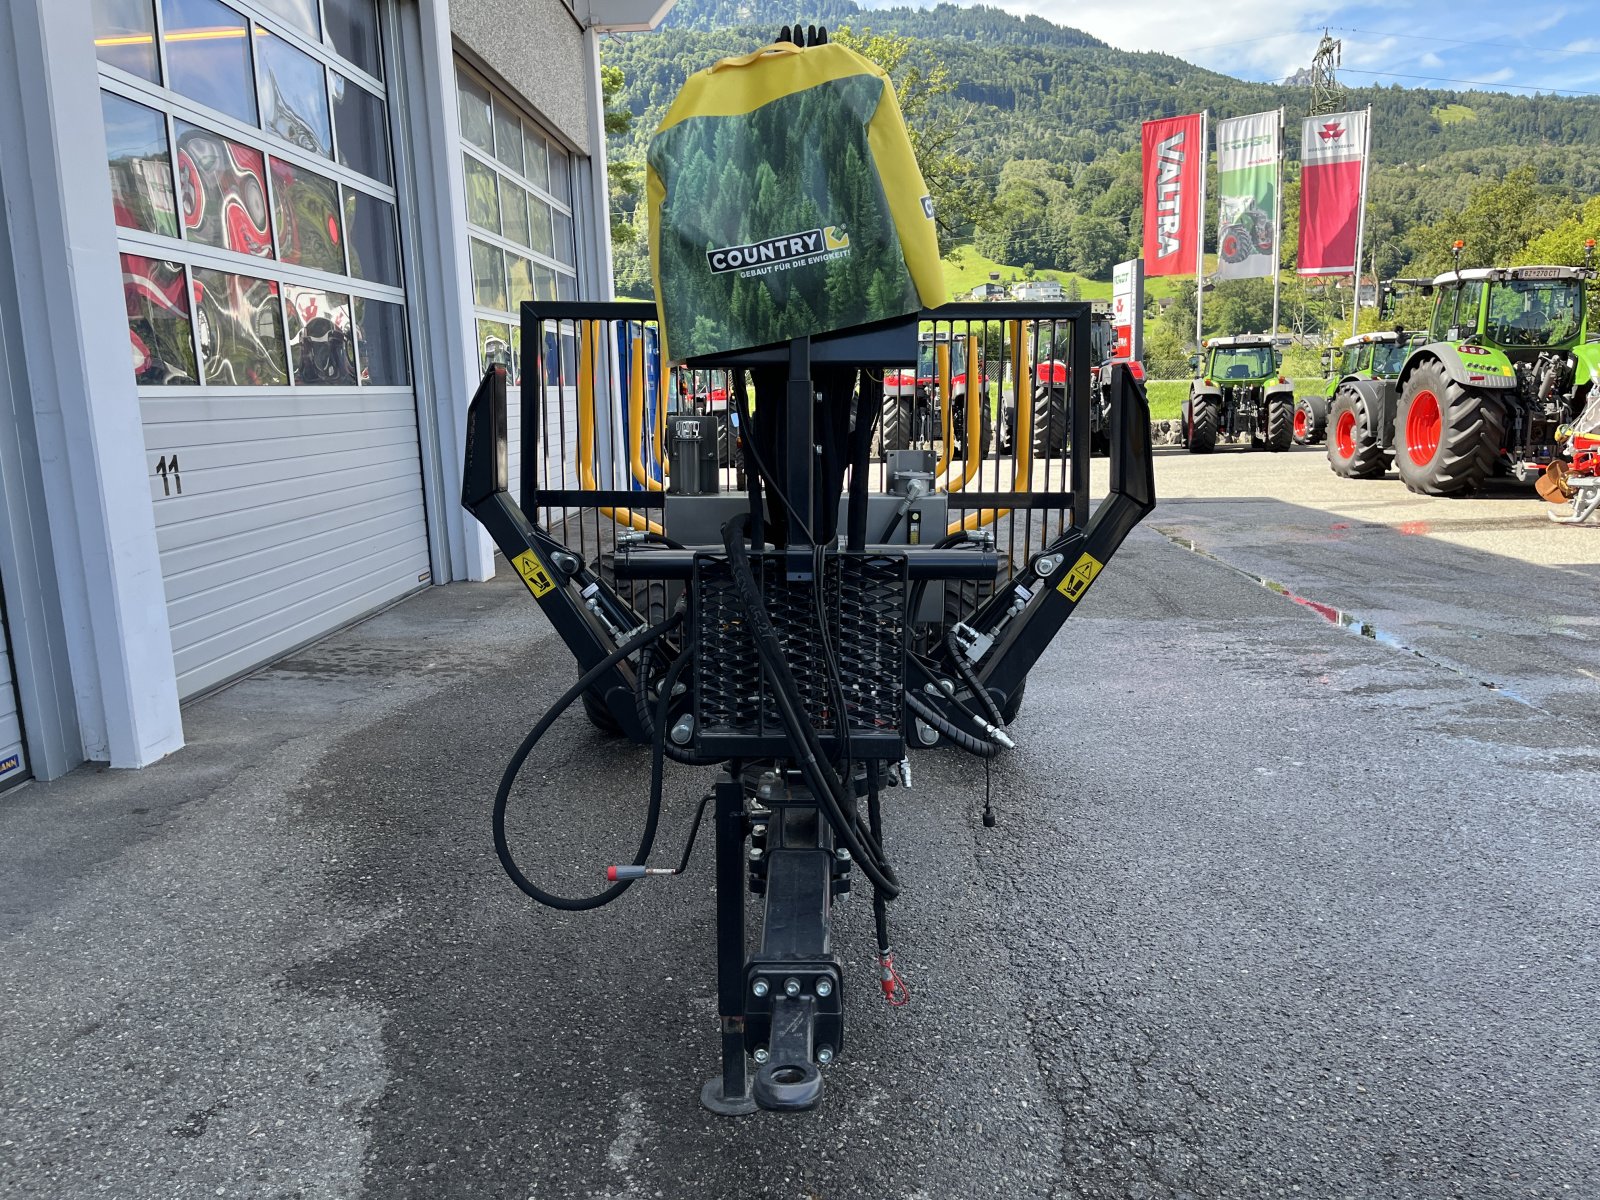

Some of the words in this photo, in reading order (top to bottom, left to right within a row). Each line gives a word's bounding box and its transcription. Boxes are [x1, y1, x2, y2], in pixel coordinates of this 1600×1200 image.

[1158, 131, 1184, 258] VALTRA
[712, 233, 817, 269] COUNTRY
[740, 266, 772, 279] GEBAUT
[774, 261, 791, 273] FÜR
[793, 258, 807, 268] DIE
[808, 249, 851, 266] EWIGKEIT!
[156, 454, 182, 496] 11
